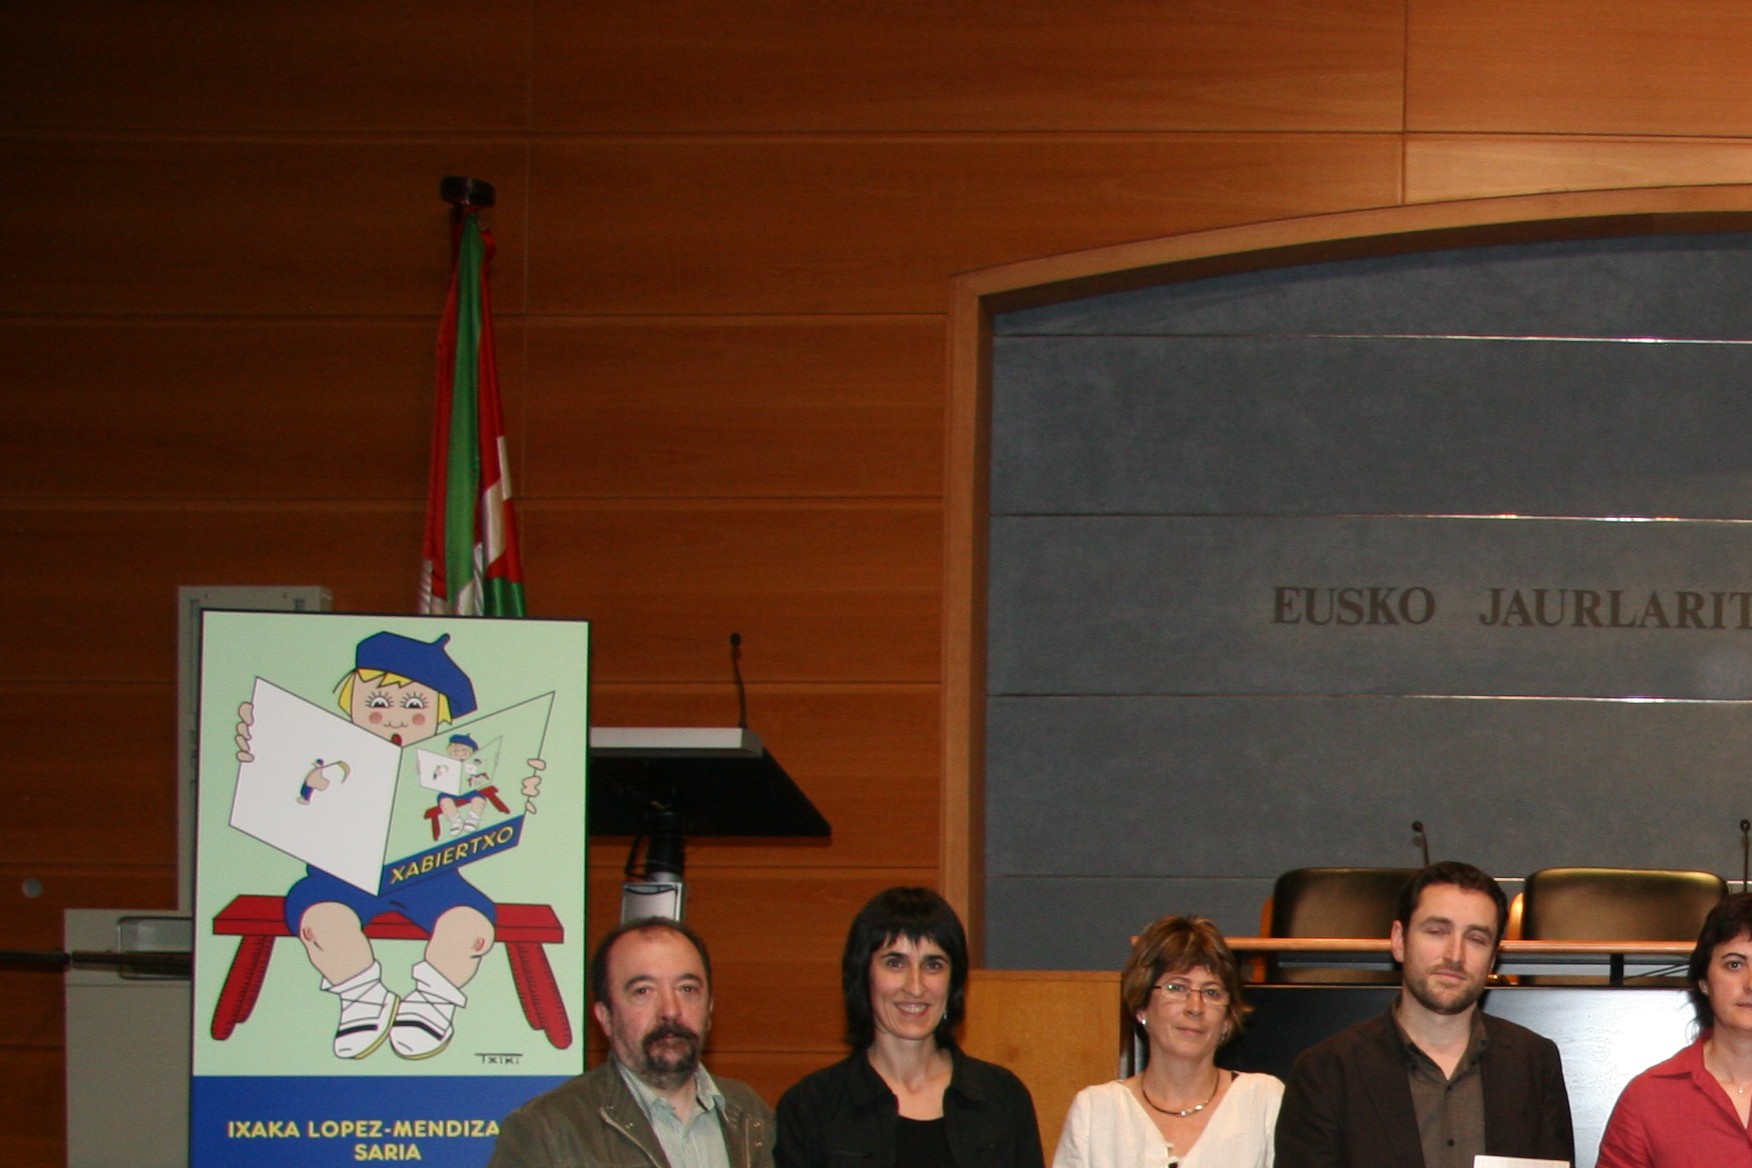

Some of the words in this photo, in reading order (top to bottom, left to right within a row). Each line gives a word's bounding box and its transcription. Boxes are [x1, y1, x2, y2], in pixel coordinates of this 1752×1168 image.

[1272, 585, 1436, 626] EUSKO
[390, 825, 514, 884] XABIERTXO
[227, 1120, 301, 1138] IXAKA
[307, 1119, 501, 1138] LOPEZ-MENDIZA
[354, 1143, 422, 1161] SARIA
